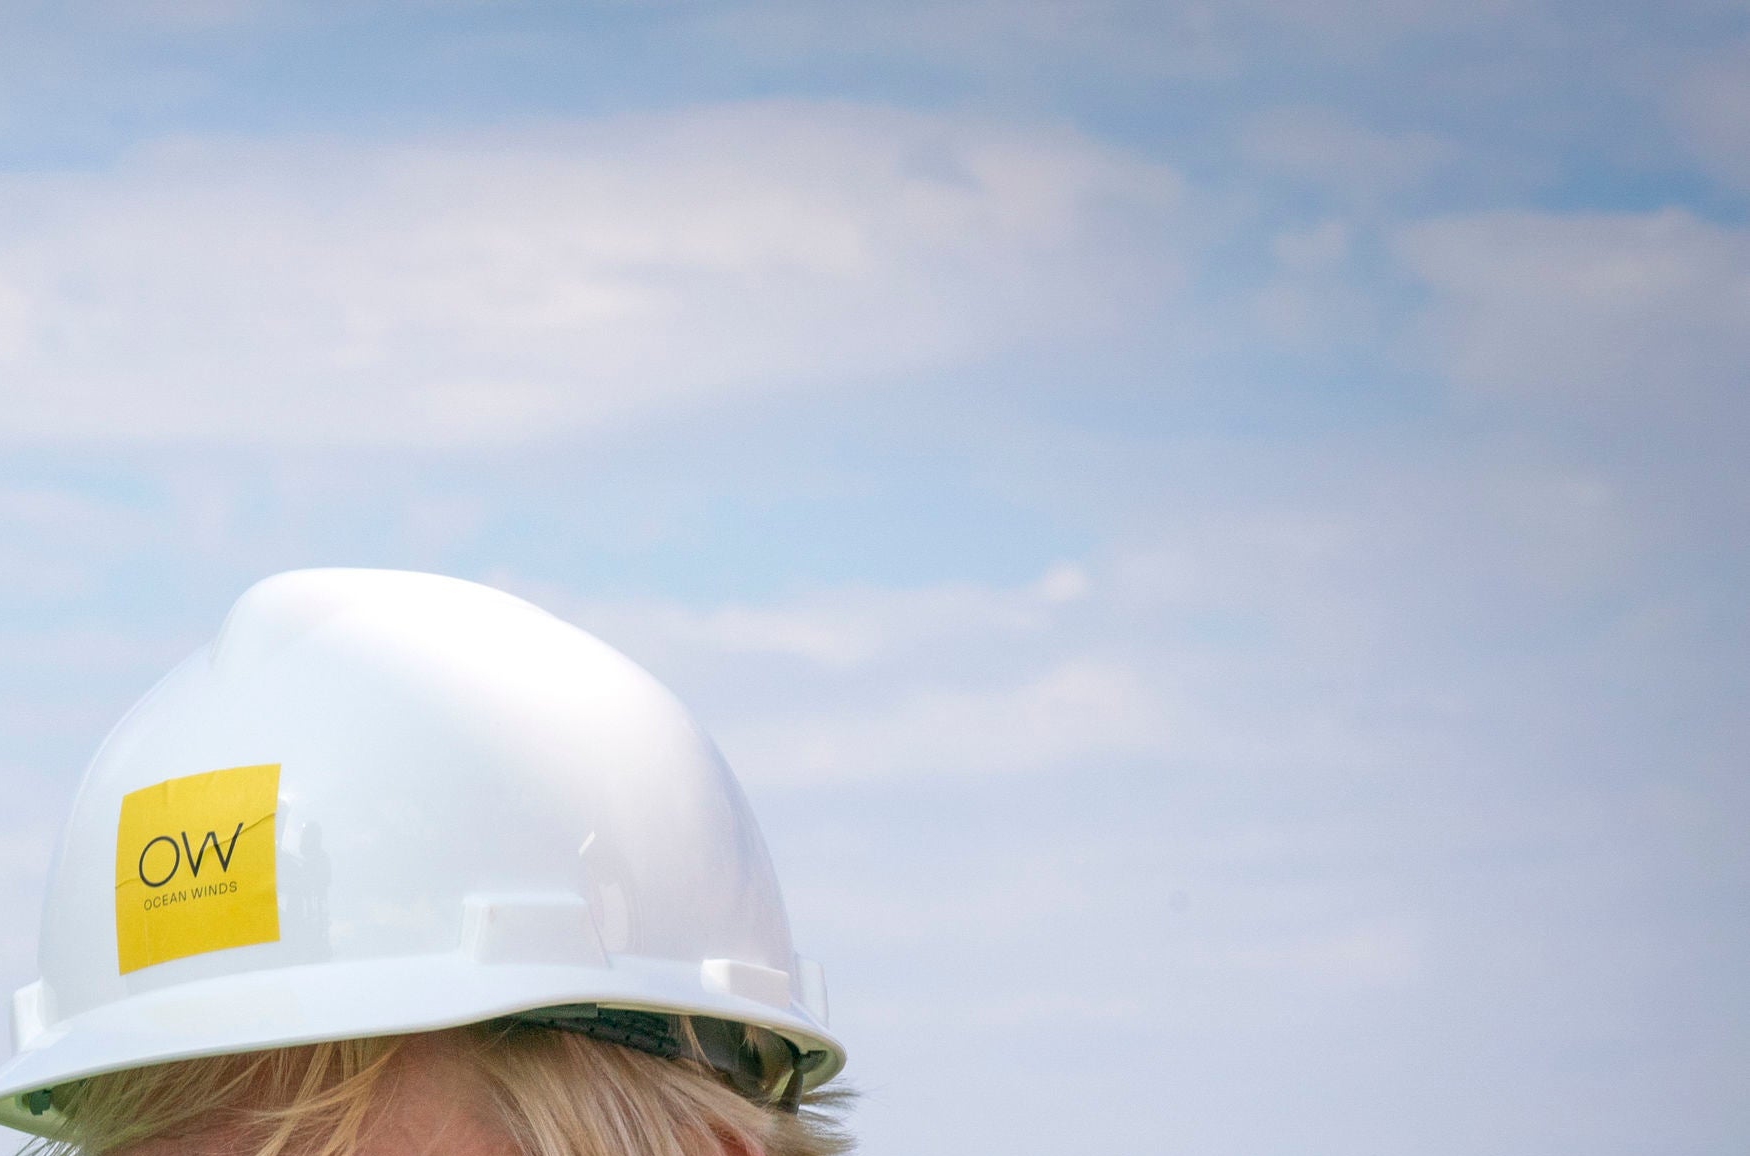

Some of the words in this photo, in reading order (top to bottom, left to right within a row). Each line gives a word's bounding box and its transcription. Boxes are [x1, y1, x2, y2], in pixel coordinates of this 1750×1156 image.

[138, 821, 245, 889] OW
[143, 891, 187, 911] OCEAN
[191, 881, 238, 900] WINDS
